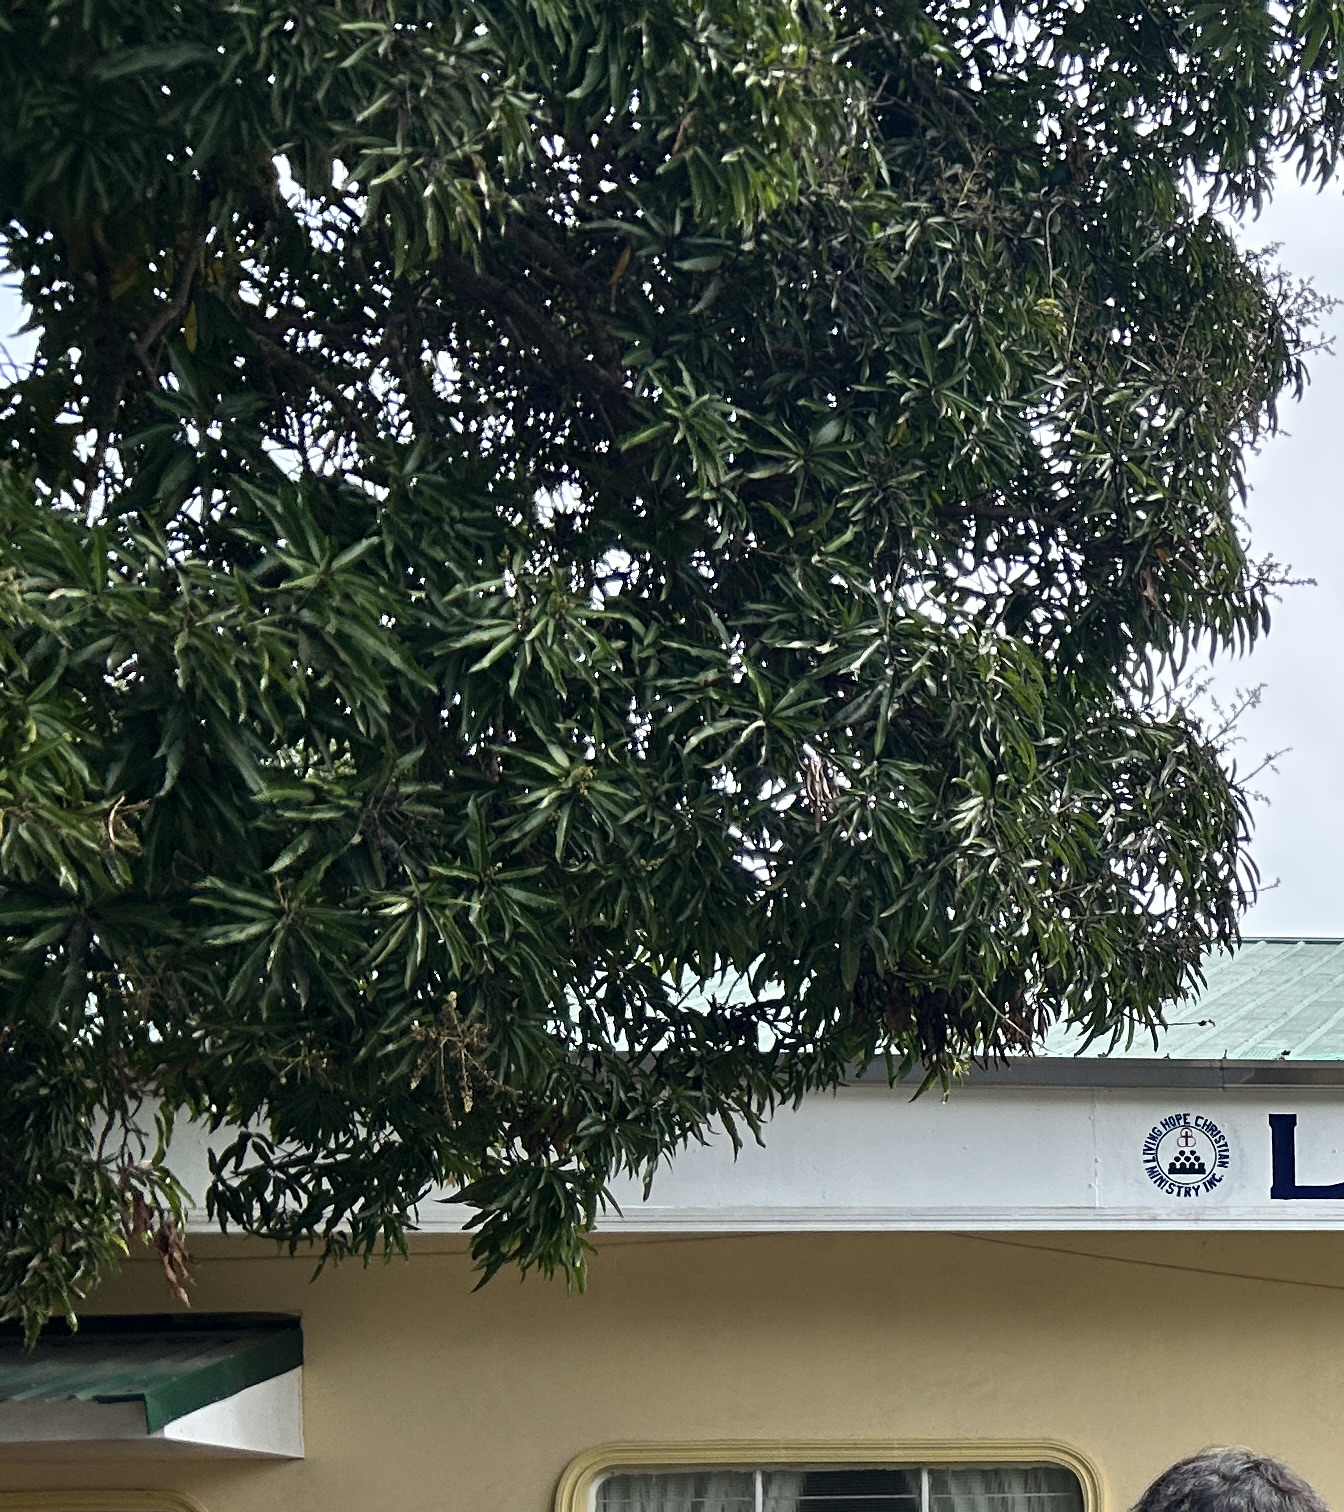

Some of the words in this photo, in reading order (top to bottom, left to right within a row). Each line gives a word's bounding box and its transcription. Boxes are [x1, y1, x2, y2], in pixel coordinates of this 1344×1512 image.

[1143, 1126, 1163, 1164] LIVING
[1160, 1113, 1191, 1131] HOPE
[1195, 1115, 1230, 1169] CHRISTIAN
[1144, 1165, 1201, 1198] MINISTRY
